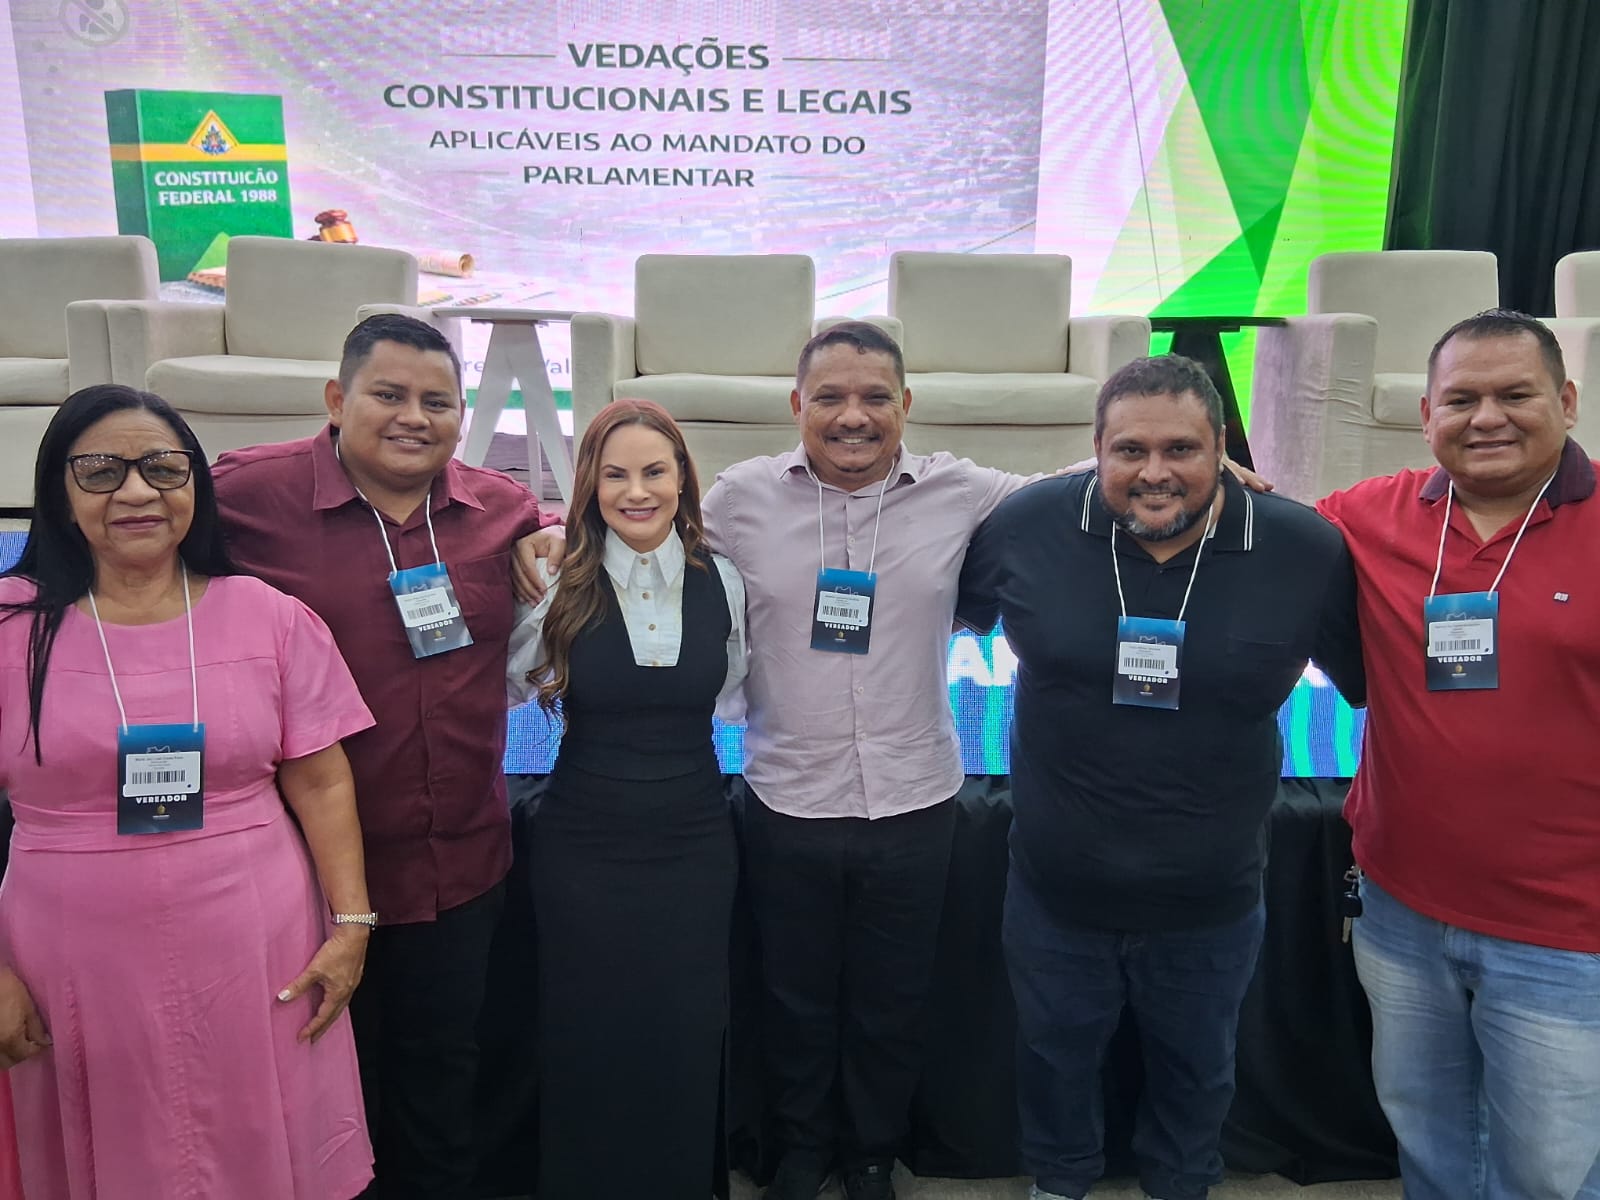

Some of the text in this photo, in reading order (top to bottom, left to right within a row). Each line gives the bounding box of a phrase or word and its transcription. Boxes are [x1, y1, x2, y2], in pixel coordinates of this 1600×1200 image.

[567, 37, 769, 76] VEDAÇÕES
[383, 84, 912, 114] CONSTITUCIONAIS E LEGAIS
[429, 127, 866, 155] APLICÁVEIS AO MANDATO DO
[524, 166, 755, 188] PARLAMENTAR
[158, 189, 278, 206] FEDERAL 1988
[1128, 674, 1168, 684] VEREADOR
[135, 794, 188, 804] VEREADOR
